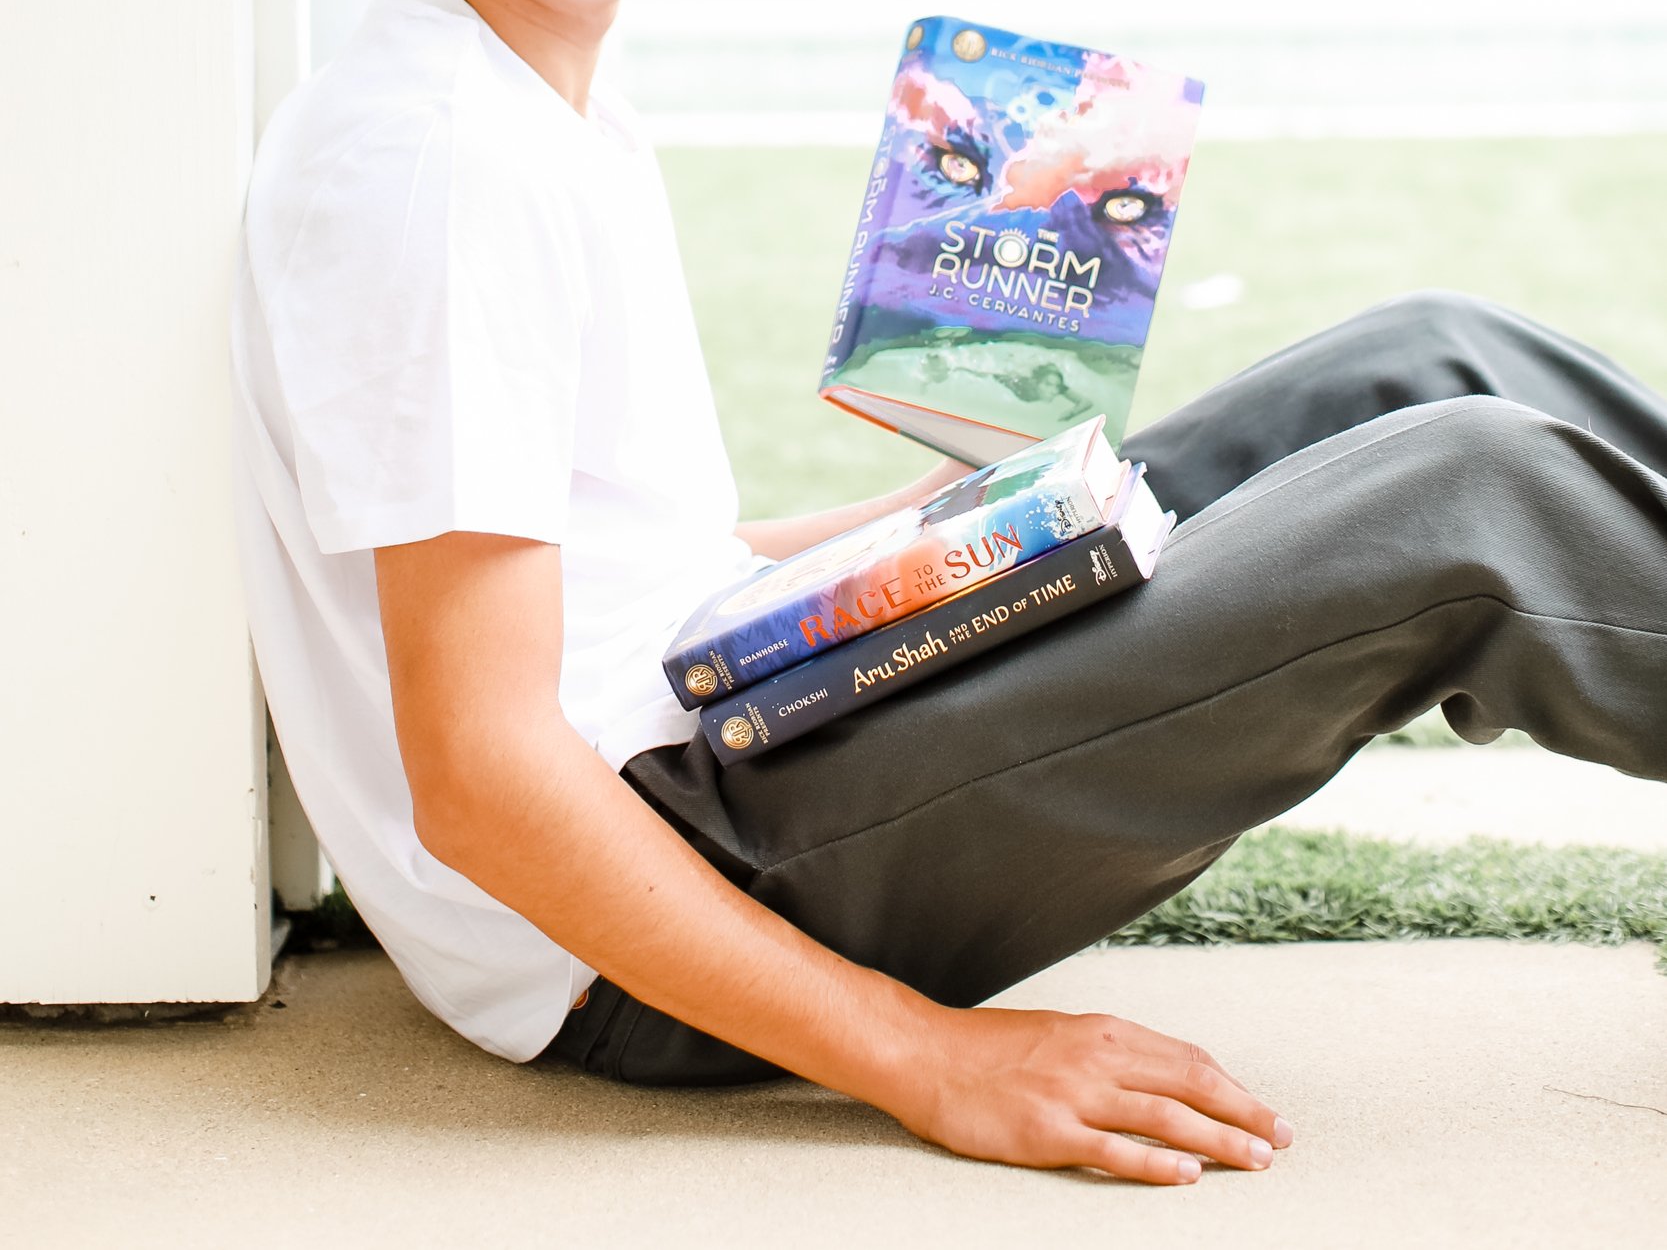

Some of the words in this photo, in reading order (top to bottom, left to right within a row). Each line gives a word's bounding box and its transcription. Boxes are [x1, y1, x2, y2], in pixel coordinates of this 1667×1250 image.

[1037, 228, 1060, 243] THE
[940, 220, 1101, 289] STORM
[932, 252, 1094, 319] RUNNER
[929, 284, 959, 301] J.C.
[968, 293, 1080, 332] CERVANTES
[944, 524, 1023, 579] SUN
[1099, 544, 1118, 578] HYPERION
[913, 563, 934, 580] TO
[914, 573, 946, 595] THE
[799, 576, 912, 648] RACE
[972, 605, 1010, 634] END
[1012, 598, 1028, 613] OF
[1029, 573, 1076, 606] TIME
[949, 623, 968, 638] AND
[951, 630, 972, 645] THE
[739, 638, 790, 667] ROANHORSE
[853, 661, 896, 694] Aru
[892, 631, 948, 672] Shah
[717, 654, 735, 683] PRESENTS
[778, 688, 829, 717] CHOKSHI
[753, 706, 771, 736] PRESENTS
